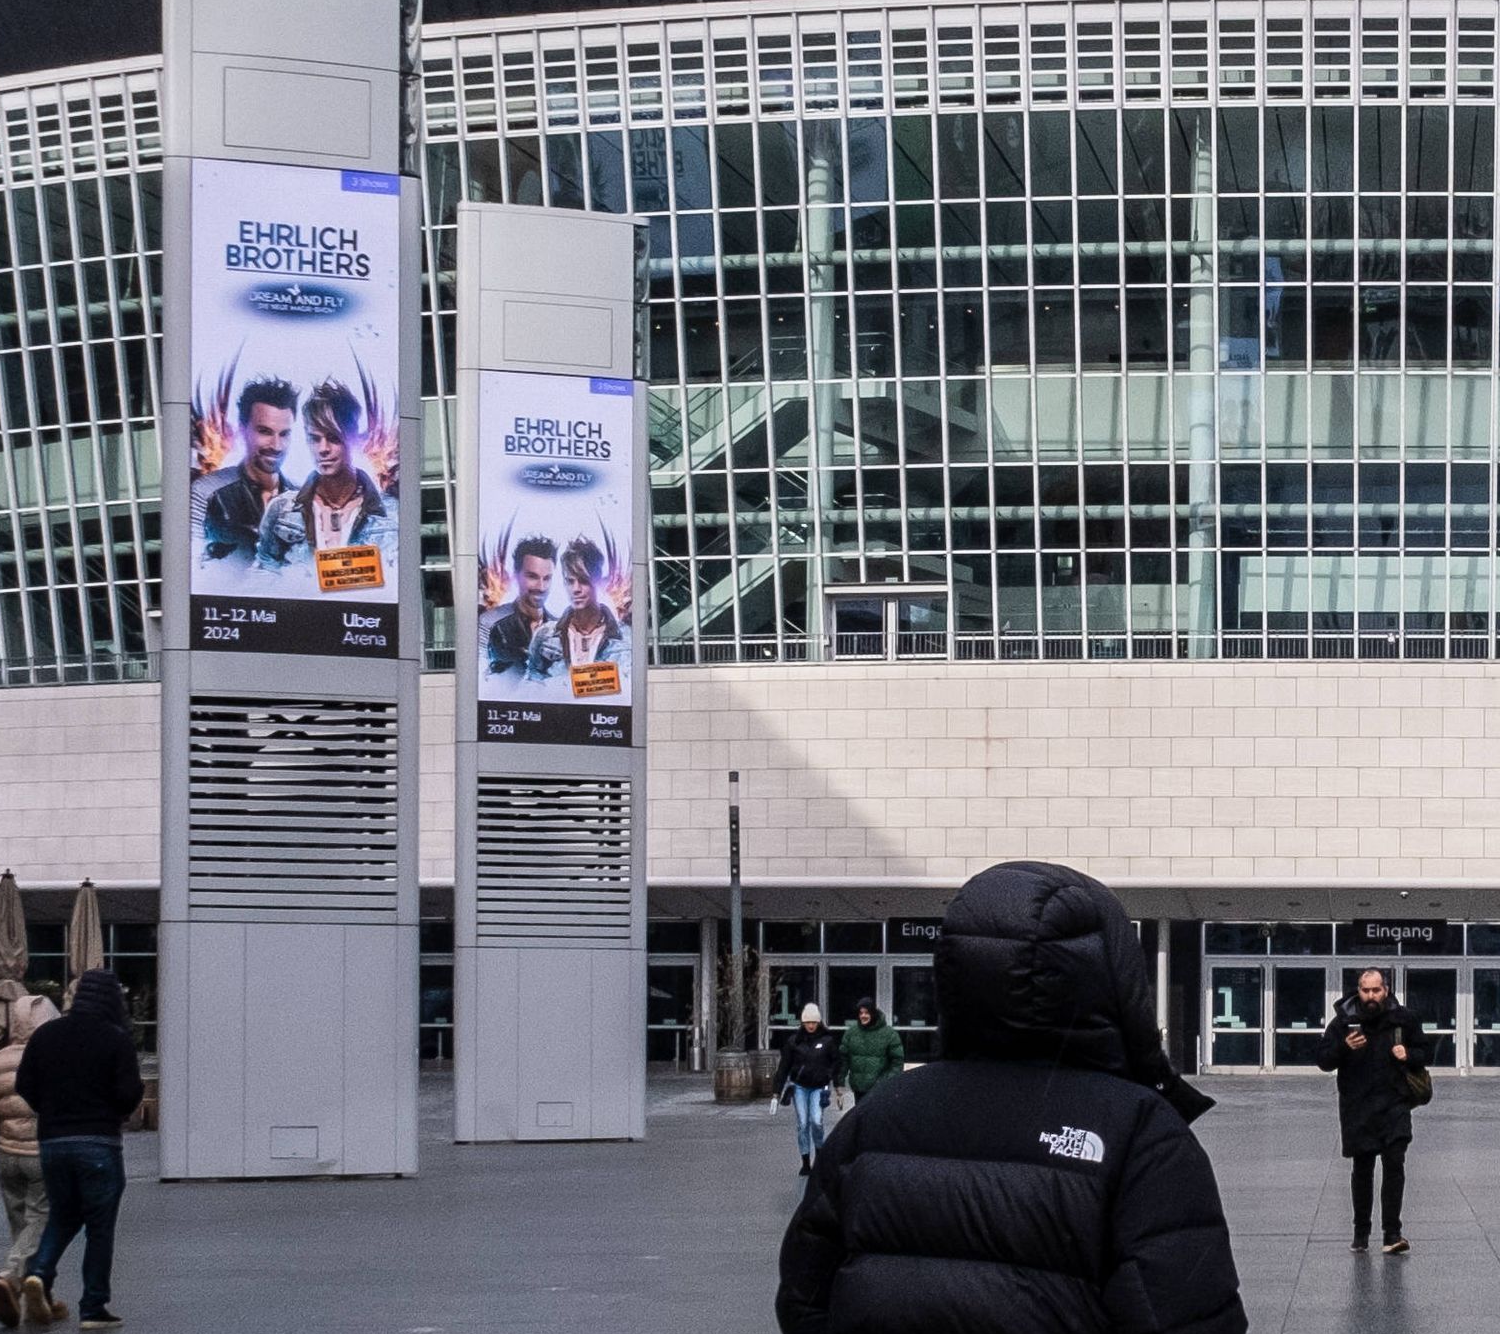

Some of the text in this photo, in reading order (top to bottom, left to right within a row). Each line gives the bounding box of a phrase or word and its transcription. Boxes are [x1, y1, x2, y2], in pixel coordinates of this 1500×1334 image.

[239, 220, 358, 251] EHRLICH
[226, 244, 370, 277] BROTHERS
[296, 295, 321, 305] AND
[324, 296, 344, 307] FLY
[514, 417, 602, 439] EHRLICH
[505, 435, 611, 458] BROTHERS
[251, 610, 277, 624] Mai
[343, 613, 381, 628] Uber
[204, 627, 240, 640] 2024
[342, 631, 386, 646] Arena
[590, 713, 618, 724] Uber
[487, 724, 514, 735] 2024
[589, 727, 623, 739] Arena
[1367, 924, 1433, 941] Eingang
[1214, 987, 1240, 1022] 1
[1039, 1131, 1084, 1149] NORTH
[1049, 1144, 1081, 1158] FACE
